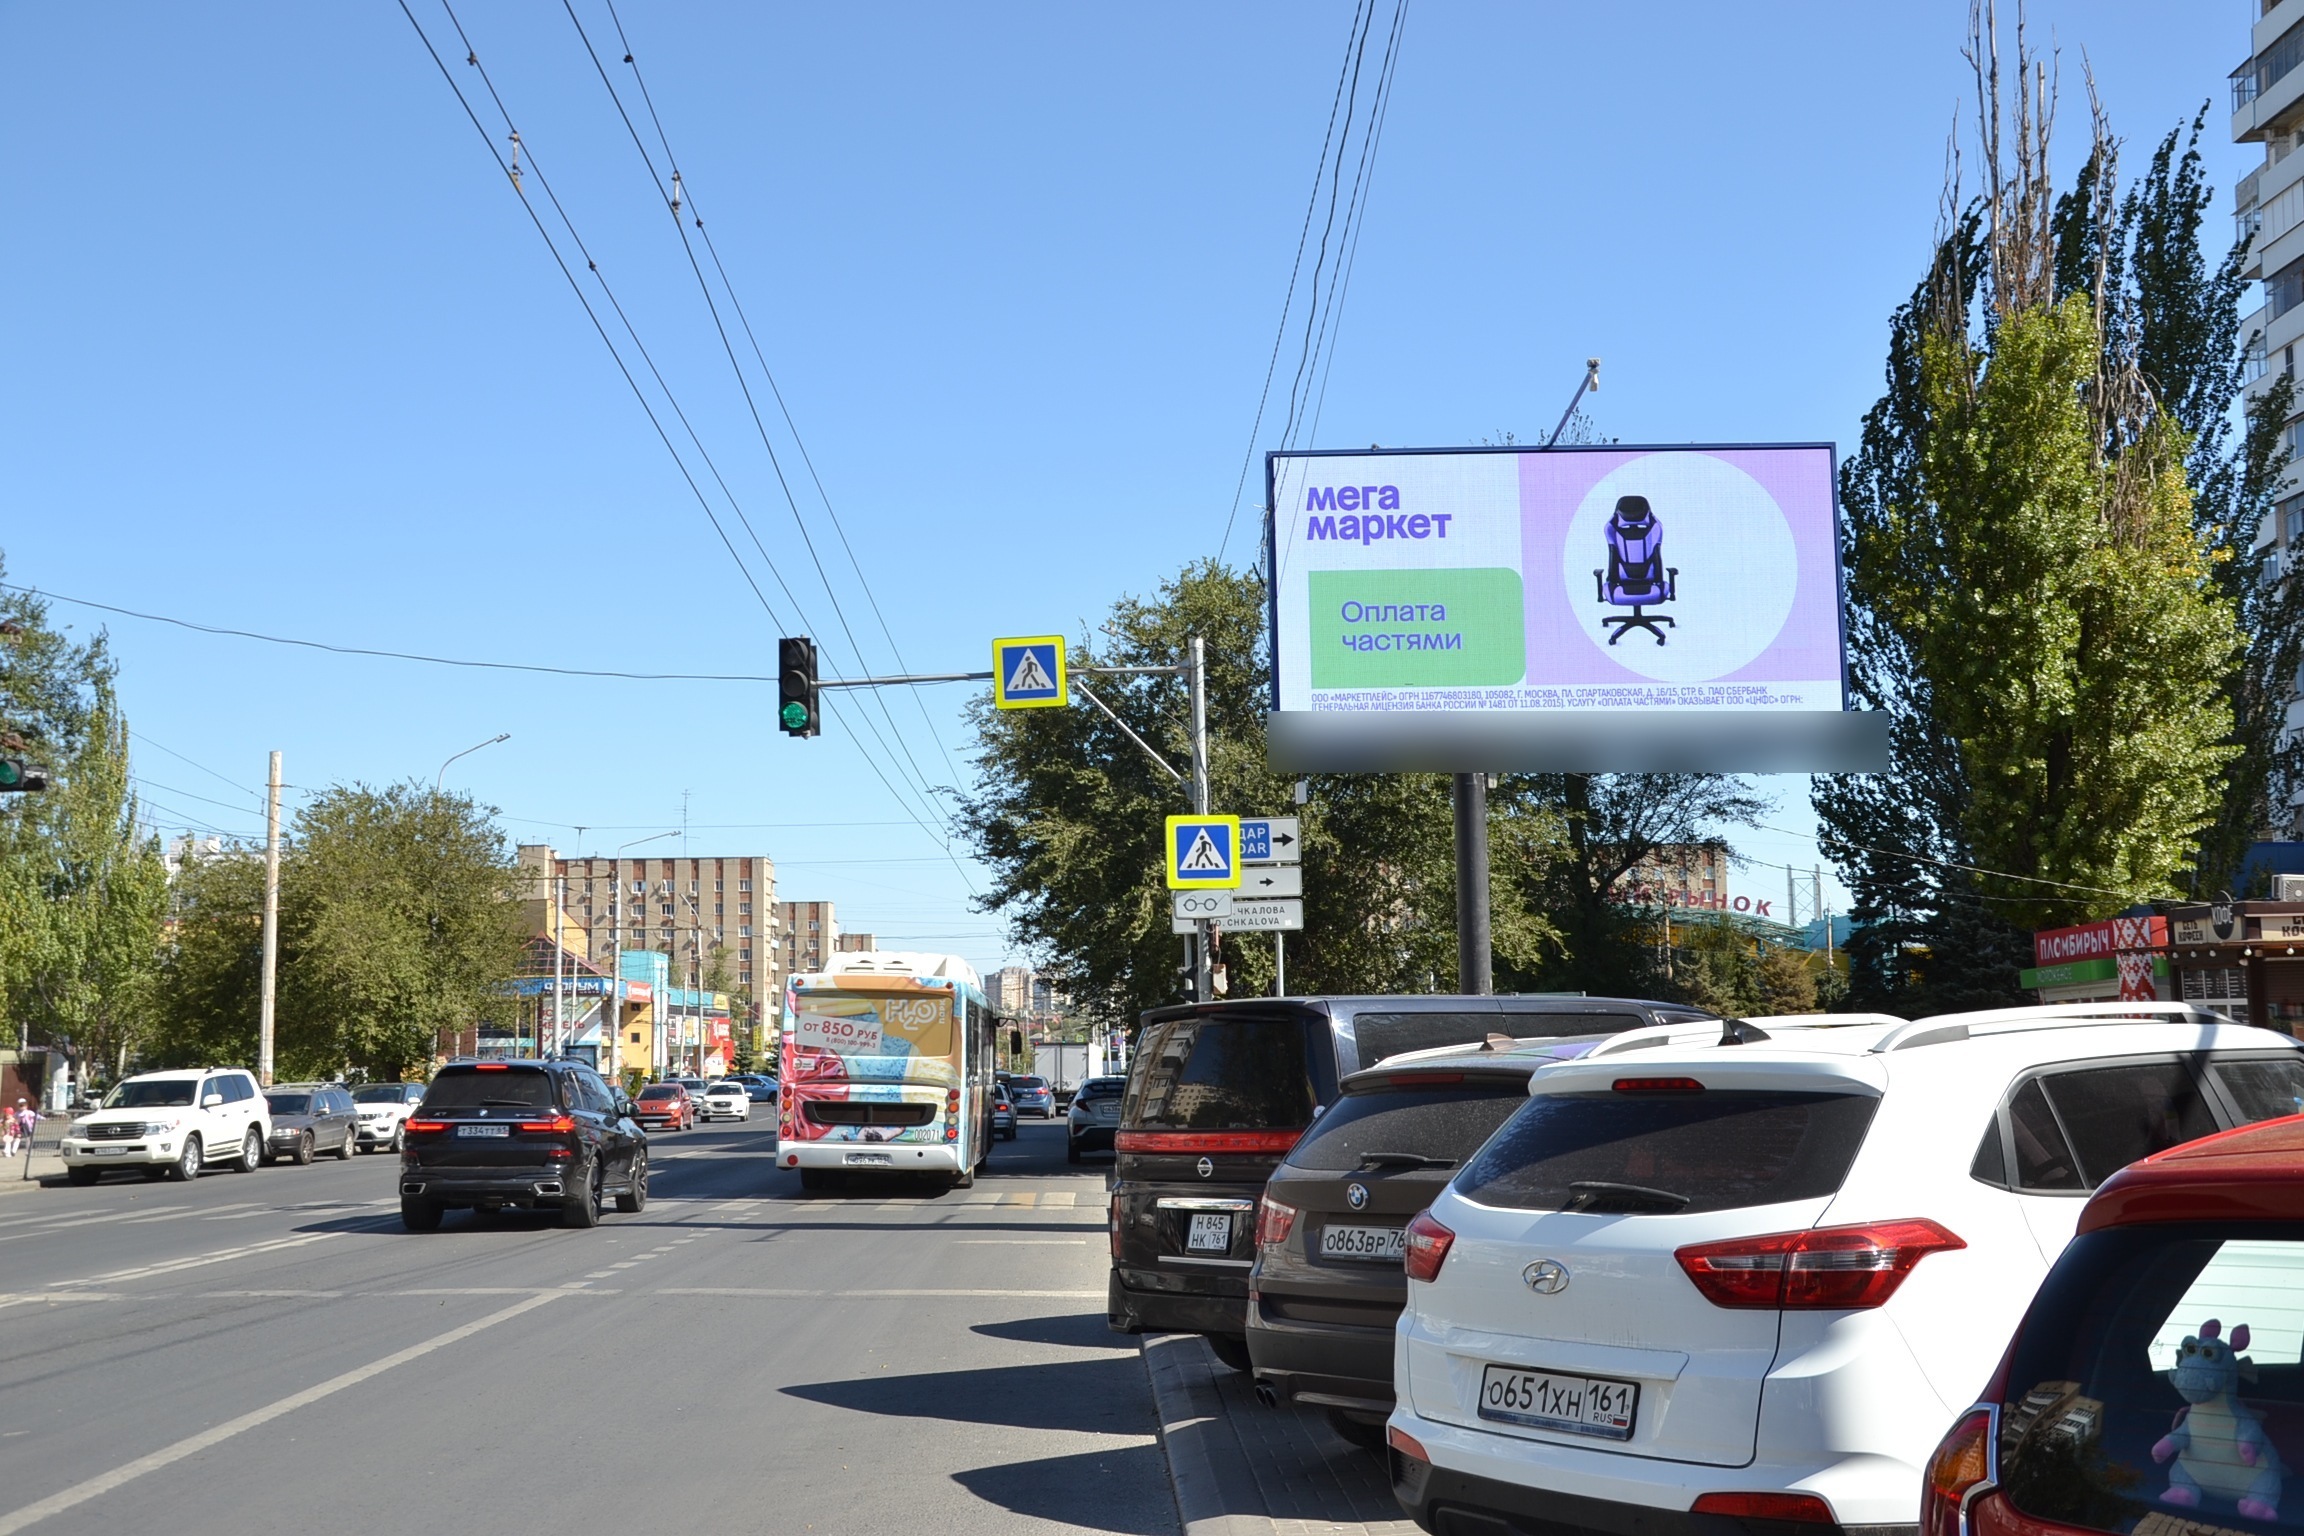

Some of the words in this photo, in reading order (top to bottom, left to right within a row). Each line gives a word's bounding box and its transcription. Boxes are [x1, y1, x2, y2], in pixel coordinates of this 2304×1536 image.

[1306, 485, 1400, 511] мега
[1307, 514, 1452, 545] маркет
[1341, 601, 1446, 623] Оплата
[1342, 633, 1462, 651] частями
[1311, 693, 1329, 702] ООО
[1331, 691, 1397, 702] «МАРКЕТПЛЕЙС»
[1399, 691, 1419, 701] ОГРН
[1525, 689, 1560, 700] МОСКВА,
[1562, 689, 1574, 698] ПЛ.
[1576, 688, 1645, 699] СПАРТАКОВСКАЯ,
[1681, 687, 1697, 696] СТР.
[1708, 687, 1725, 696] ПАО
[1726, 686, 1768, 696] СБЕРБАНК
[1371, 701, 1414, 711] ЛИЦЕНЗИЯ
[1416, 701, 1441, 710] БАНКА
[1443, 700, 1477, 710] РОССИИ
[1489, 700, 1506, 709] 1481
[1508, 699, 1517, 709] ОТ
[1567, 698, 1596, 707] УСЛУГУ
[1598, 698, 1632, 707] «ОПЛАТА
[1633, 696, 1676, 706] ЧАСТЯМИ»
[1677, 696, 1725, 705] ОКАЗЫВАЕТ
[1727, 695, 1744, 705] ООО
[1780, 695, 1803, 704] ОГРН:
[1240, 827, 1266, 841] ДАР
[1240, 843, 1267, 854] DAR
[1237, 906, 1285, 916] ЧКАЛОВА
[1668, 888, 1773, 917] РЫНОК
[1227, 917, 1279, 926] CHKALOVA
[2211, 904, 2234, 926] КОФЕ
[2040, 929, 2109, 960] ПЛОМБИРЫЧ
[803, 1022, 819, 1032] ОТ
[821, 1020, 854, 1037] 850
[857, 1029, 878, 1041] РУБ
[1196, 1216, 1204, 1229] Н
[1206, 1216, 1224, 1230] 845
[1191, 1233, 1206, 1247] НК
[1211, 1233, 1226, 1245] 761
[1326, 1229, 1386, 1253] О863ВР
[1390, 1231, 1405, 1248] 76
[1489, 1375, 1582, 1417] О651ХН
[1588, 1384, 1627, 1414] 161
[1593, 1412, 1613, 1423] RUS
